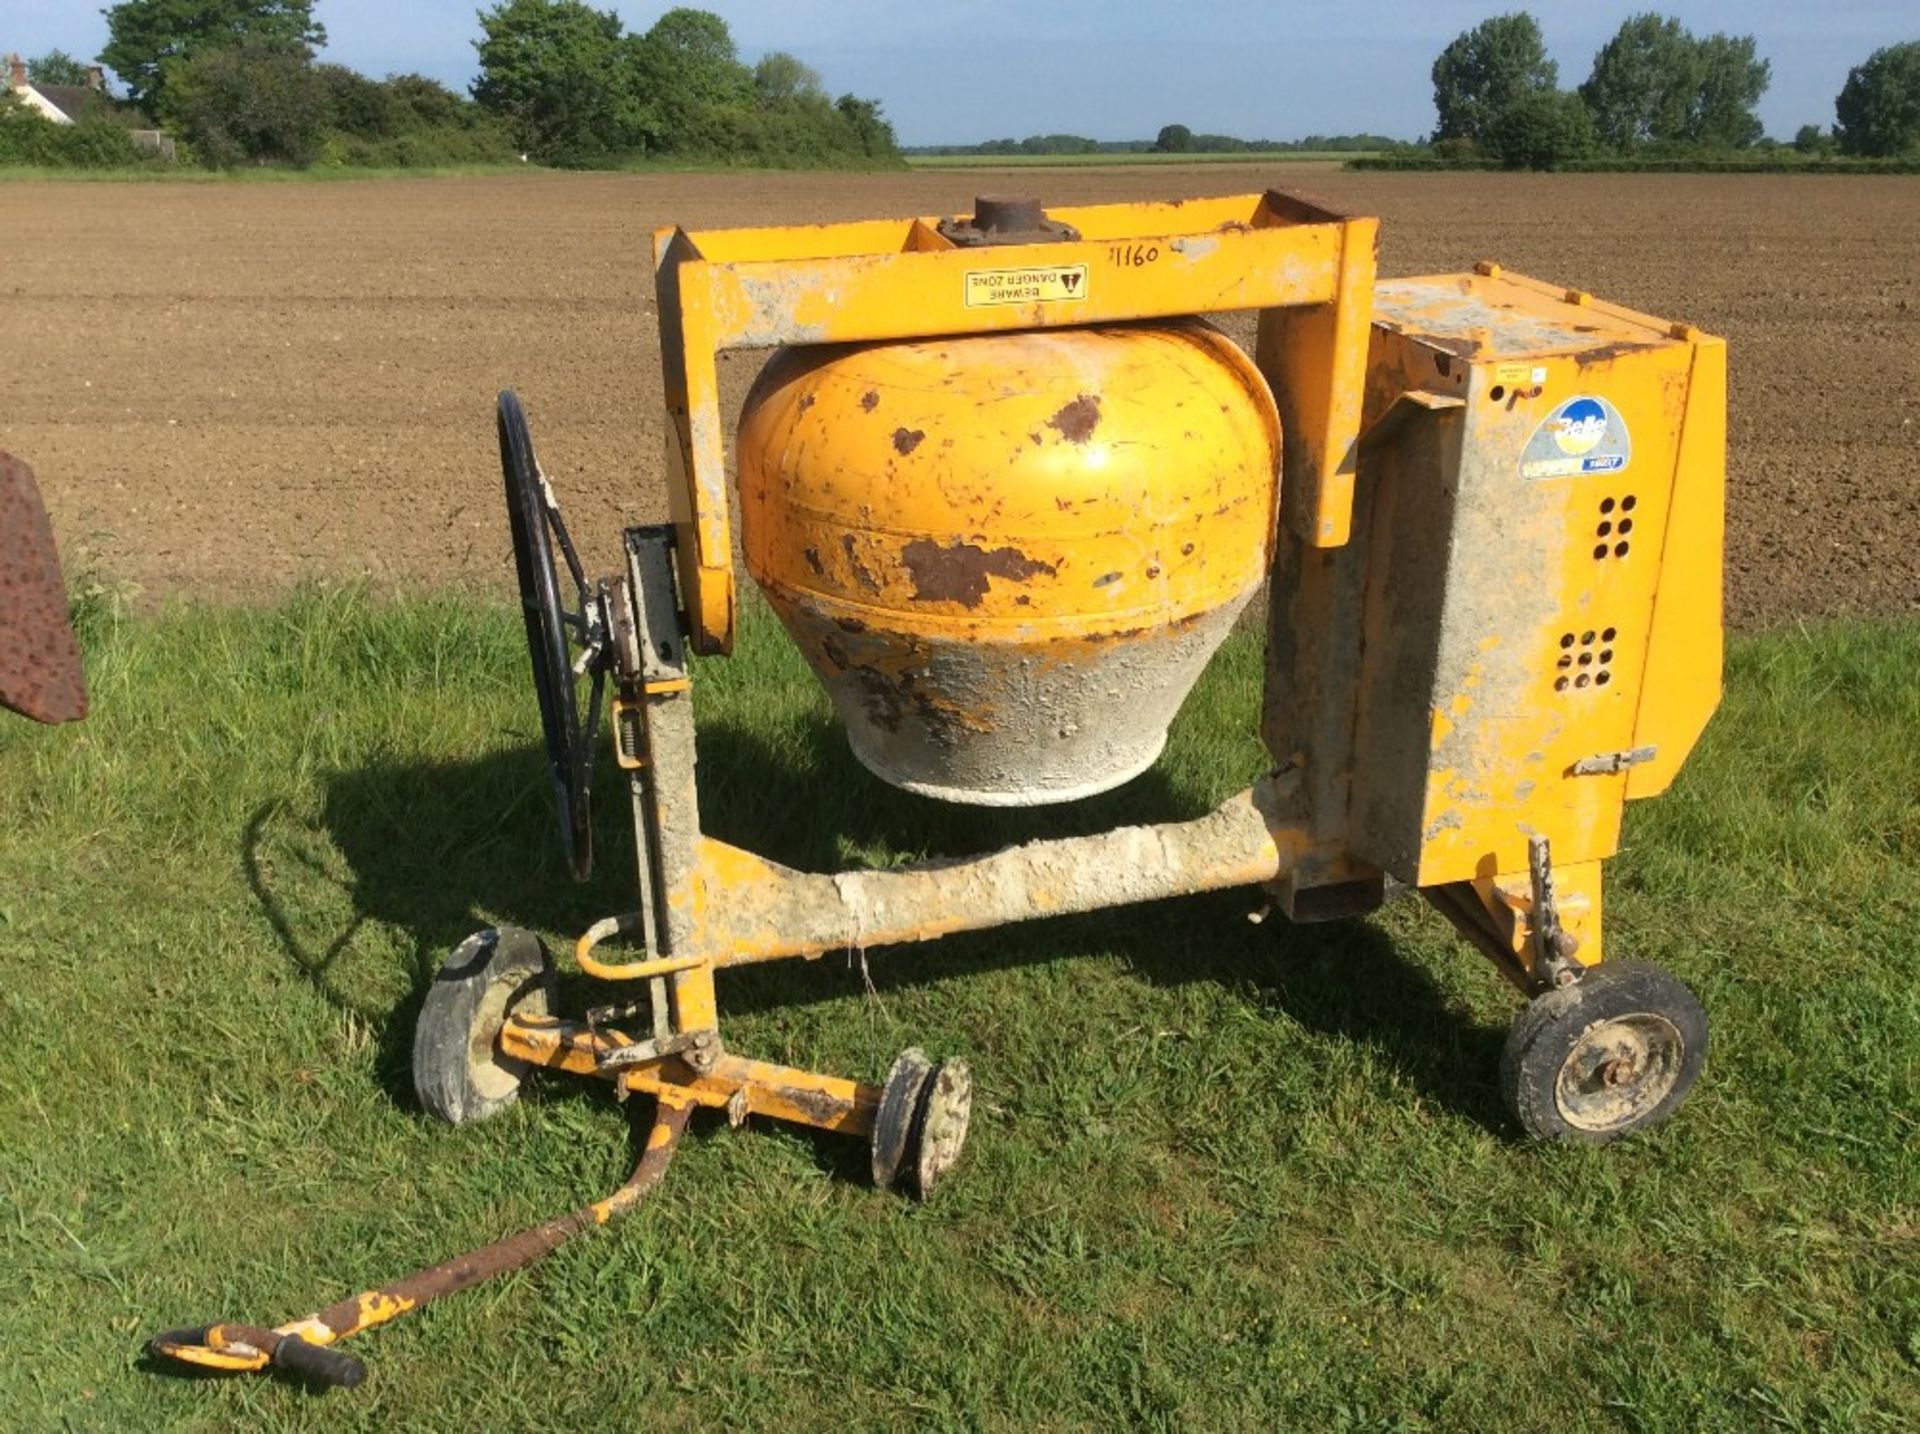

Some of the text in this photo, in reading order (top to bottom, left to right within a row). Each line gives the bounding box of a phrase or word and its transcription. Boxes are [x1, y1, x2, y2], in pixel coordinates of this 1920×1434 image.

[971, 272, 1057, 287] DANGER ZONE
[989, 287, 1040, 300] BEWARE
